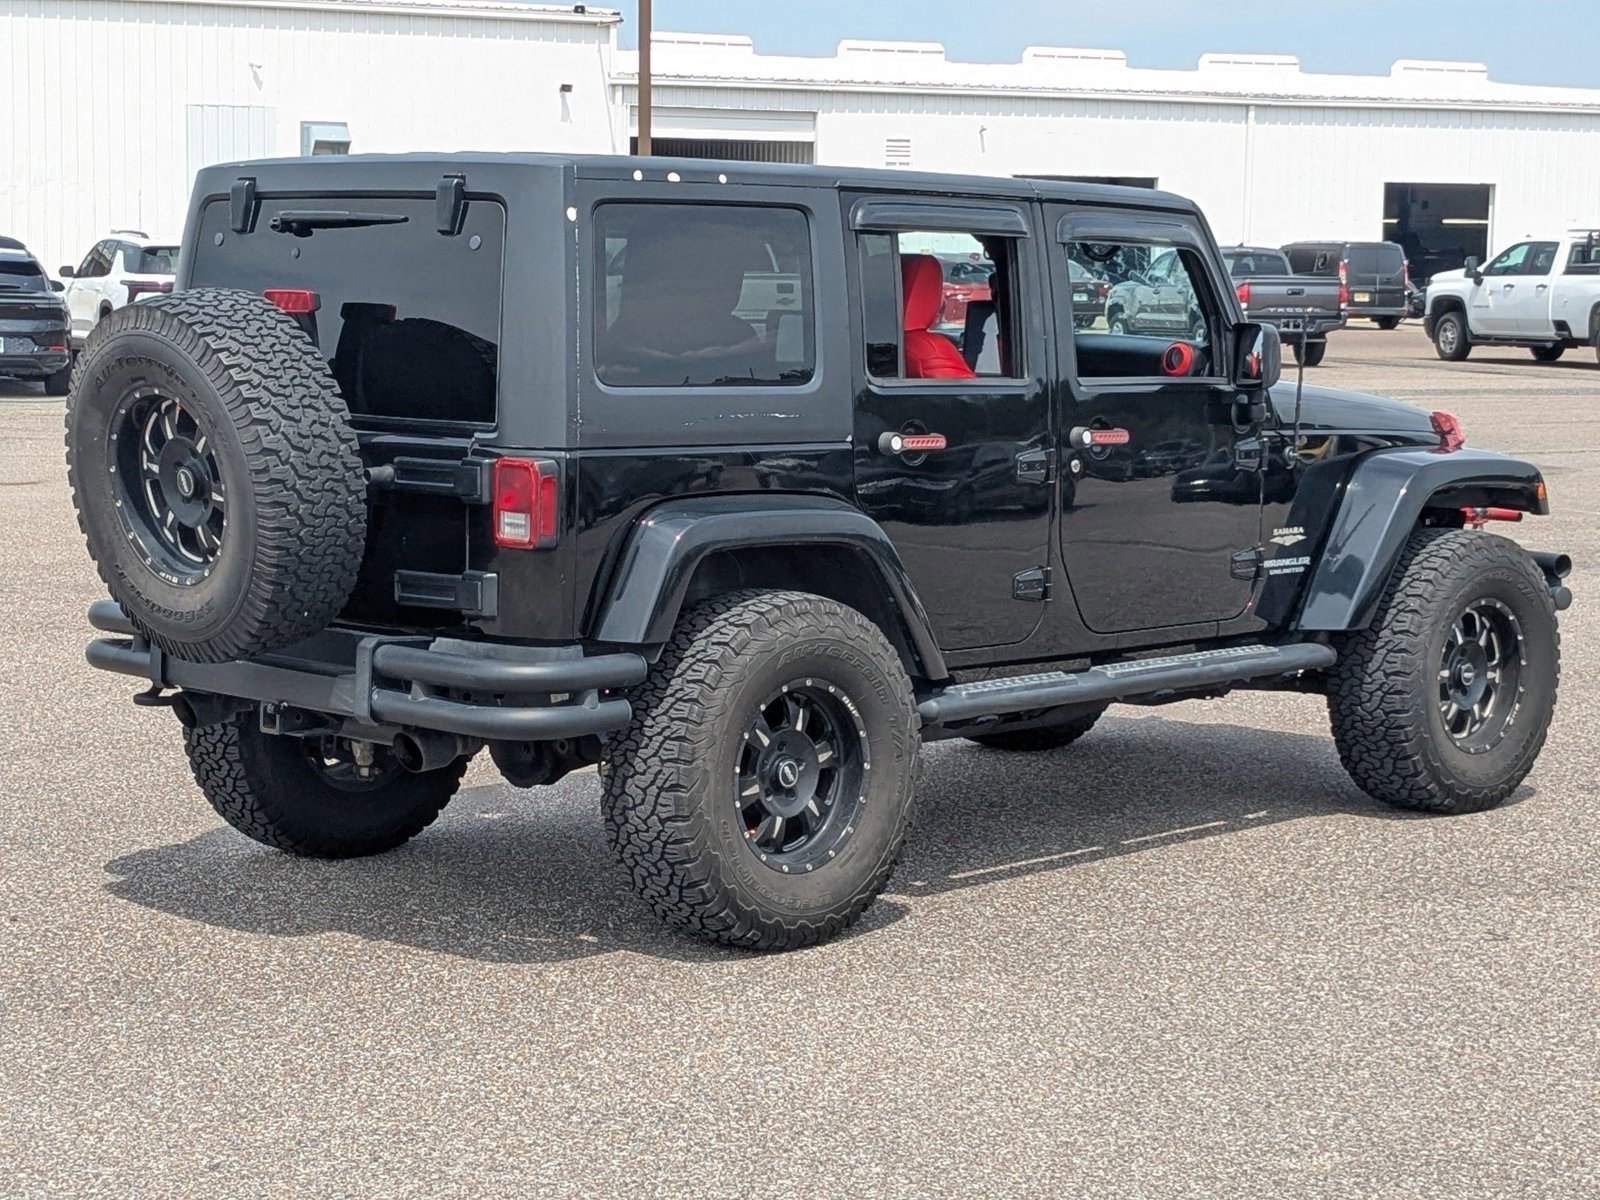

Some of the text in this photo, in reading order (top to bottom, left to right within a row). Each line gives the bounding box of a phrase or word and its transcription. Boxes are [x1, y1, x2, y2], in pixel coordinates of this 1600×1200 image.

[1272, 526, 1305, 536] SAHARA
[1263, 556, 1311, 568] WRANGLER
[1269, 566, 1305, 575] UNLIMITED
